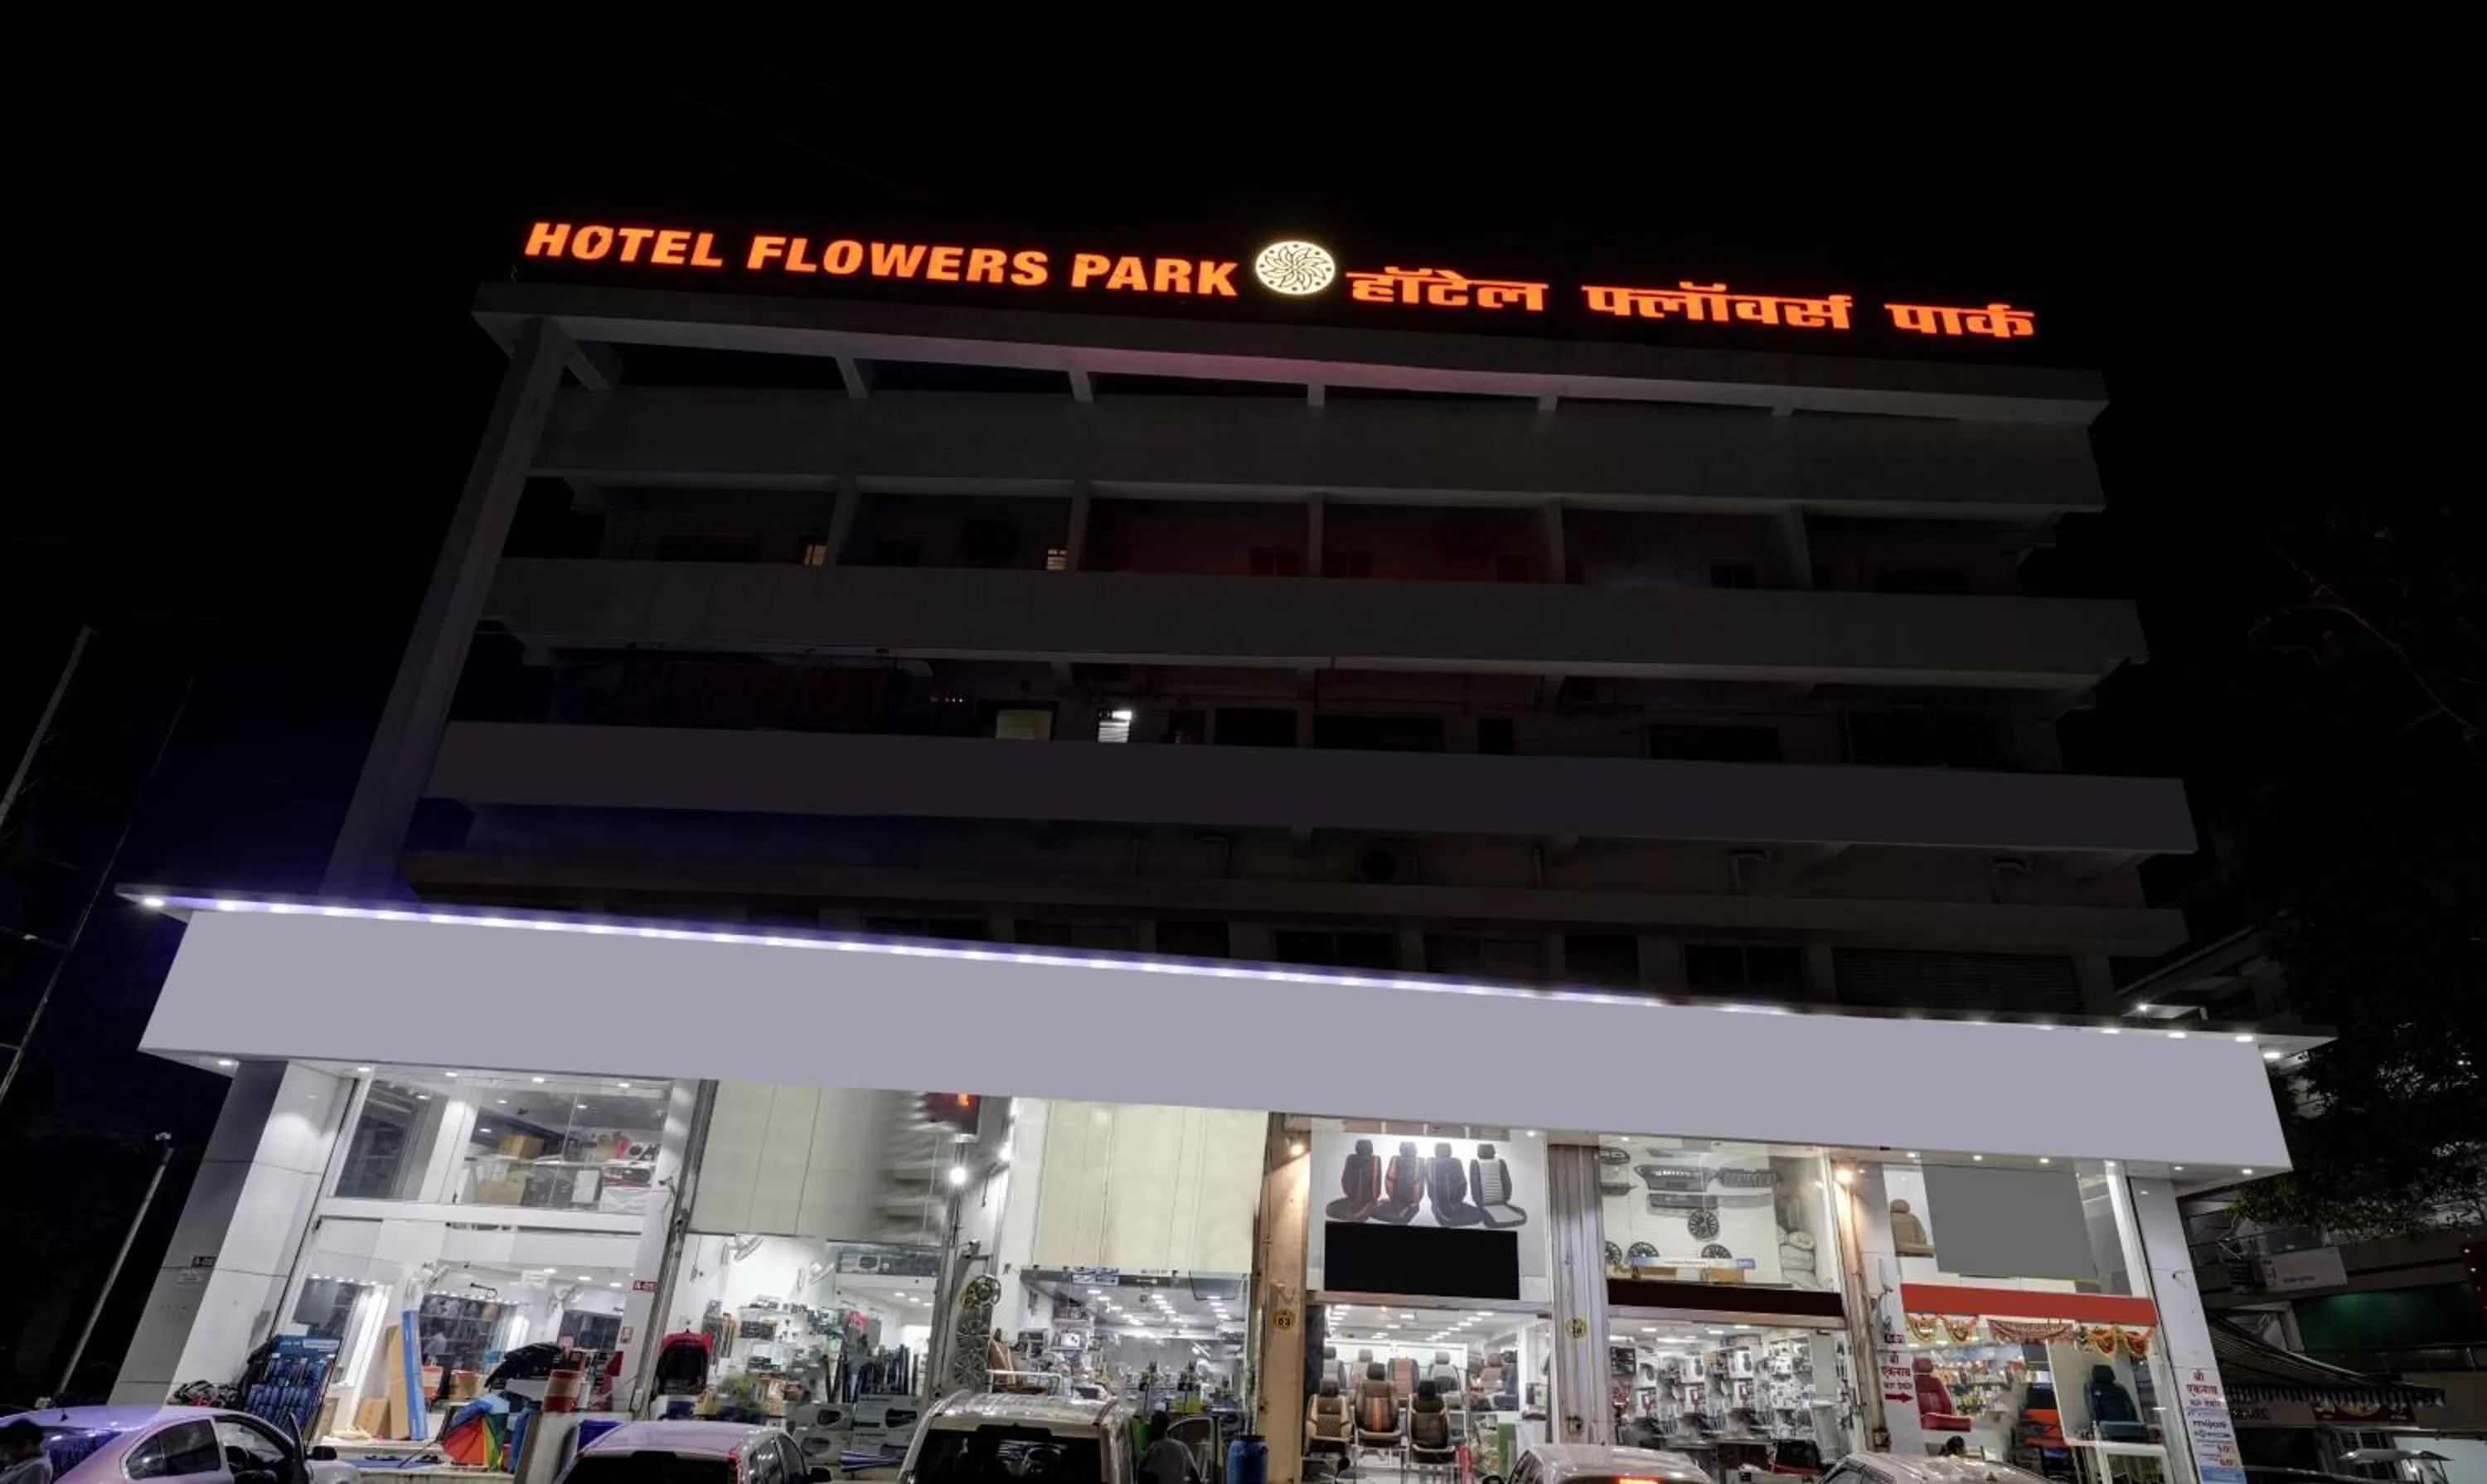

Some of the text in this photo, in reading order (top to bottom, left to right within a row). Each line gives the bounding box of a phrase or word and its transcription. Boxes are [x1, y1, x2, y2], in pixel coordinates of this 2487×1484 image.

[524, 222, 1238, 296] HOTEL FLOWERS PARK
[1345, 266, 1549, 311] हॉटेल
[1883, 303, 2034, 337] पार्क
